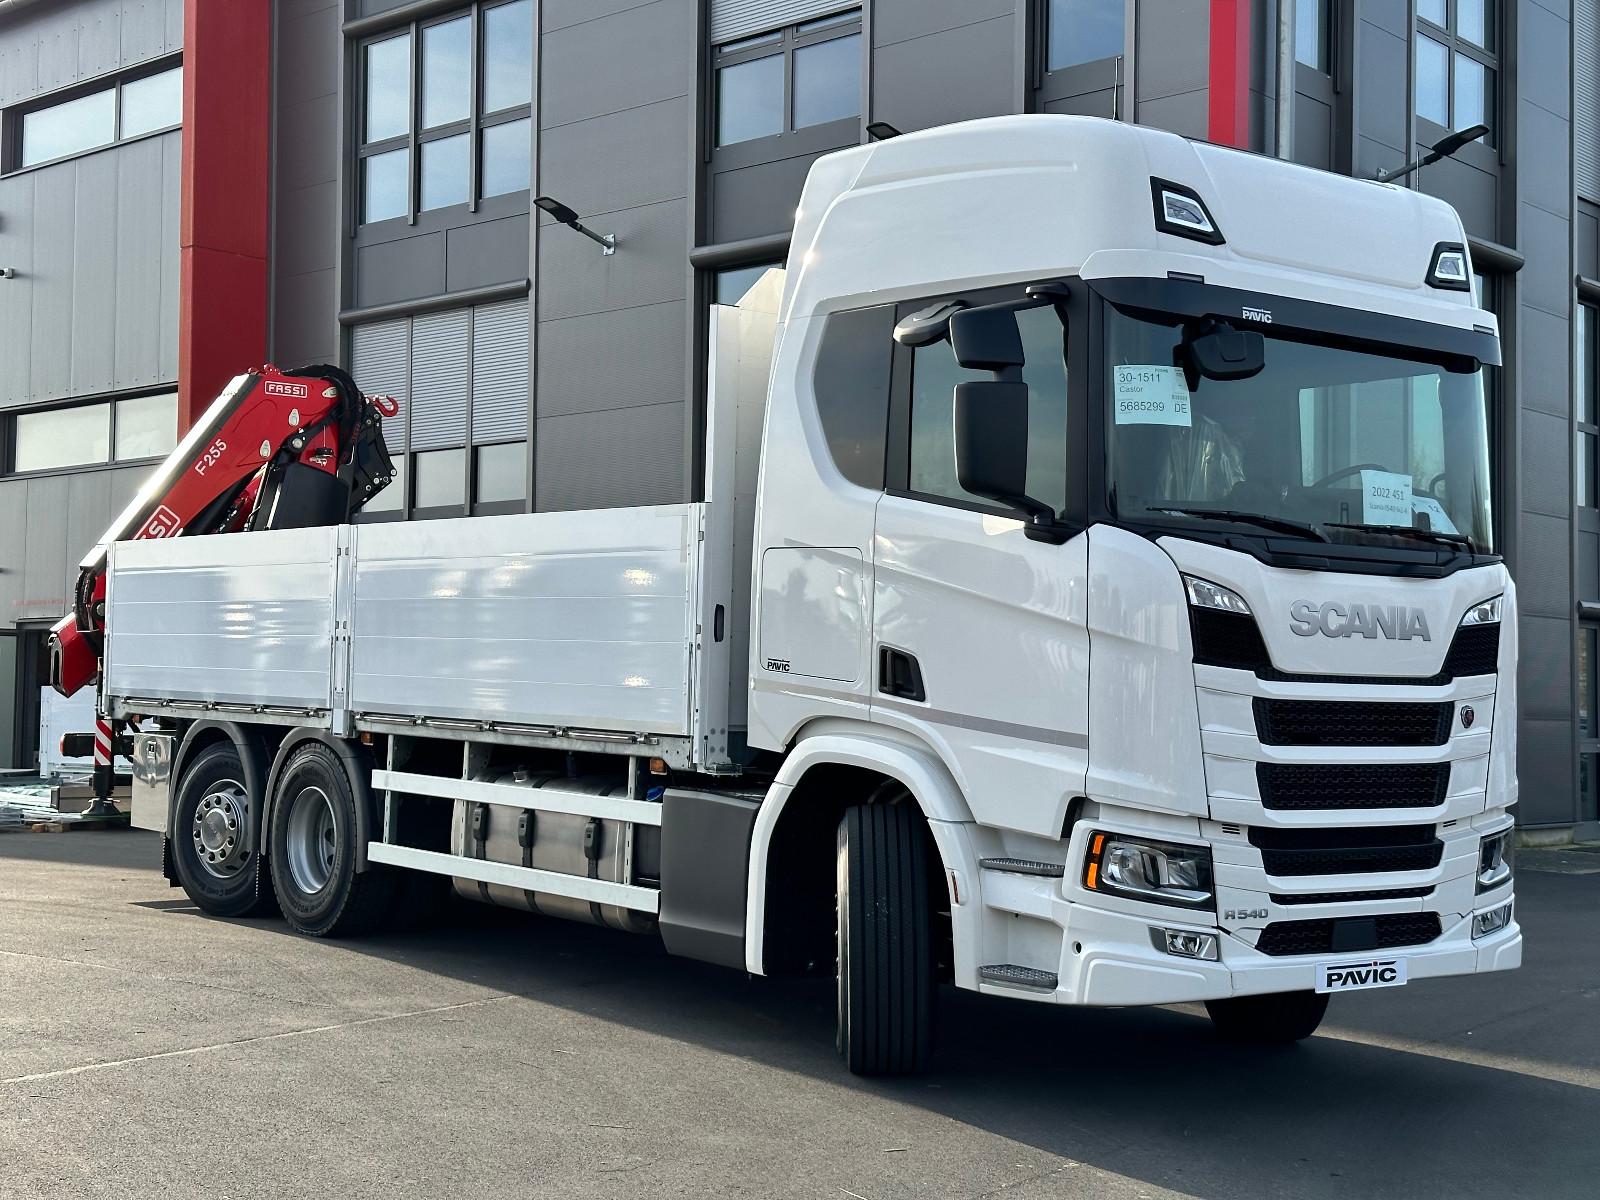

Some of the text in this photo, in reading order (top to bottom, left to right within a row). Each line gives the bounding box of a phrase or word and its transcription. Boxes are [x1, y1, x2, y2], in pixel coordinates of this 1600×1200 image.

[1242, 307, 1272, 324] PAVIC
[1119, 372, 1161, 383] 30-1511
[268, 384, 304, 396] FASSI
[1120, 401, 1165, 412] 5685299
[1174, 403, 1188, 414] DE
[1289, 600, 1432, 641] SCANIA
[767, 658, 791, 672] PAVIC
[1326, 961, 1397, 988] PAVIC
